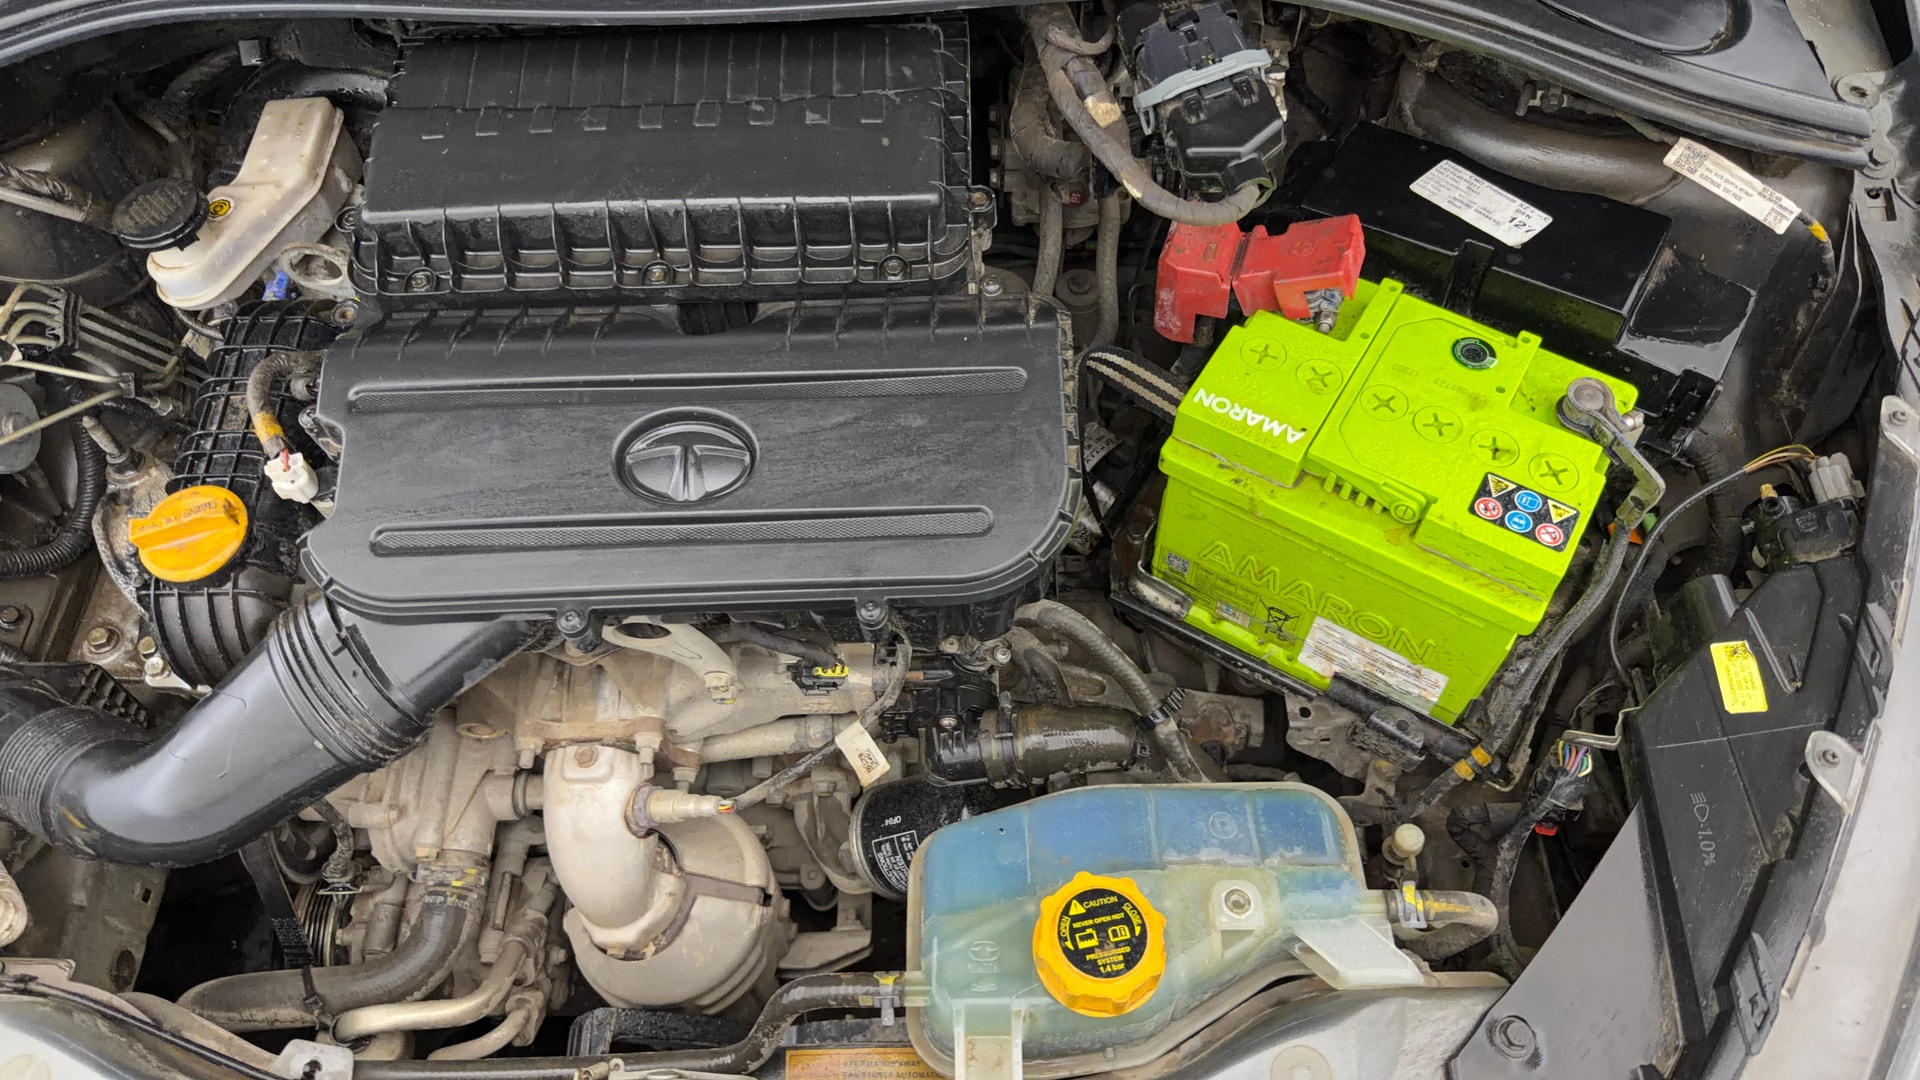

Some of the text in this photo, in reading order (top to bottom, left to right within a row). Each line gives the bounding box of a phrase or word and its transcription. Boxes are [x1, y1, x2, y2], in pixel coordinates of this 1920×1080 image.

[1468, 175, 1485, 185] CNG
[1192, 387, 1305, 444] AMARON
[1198, 540, 1437, 666] AMARON
[1082, 896, 1118, 908] CAUTION
[1072, 912, 1125, 928] NEVER OPEN HOT
[1123, 902, 1142, 924] CLOSE
[1060, 915, 1068, 937] OPEN
[1097, 954, 1124, 966] SYSTEM
[1100, 963, 1125, 973] 1.4 bar
